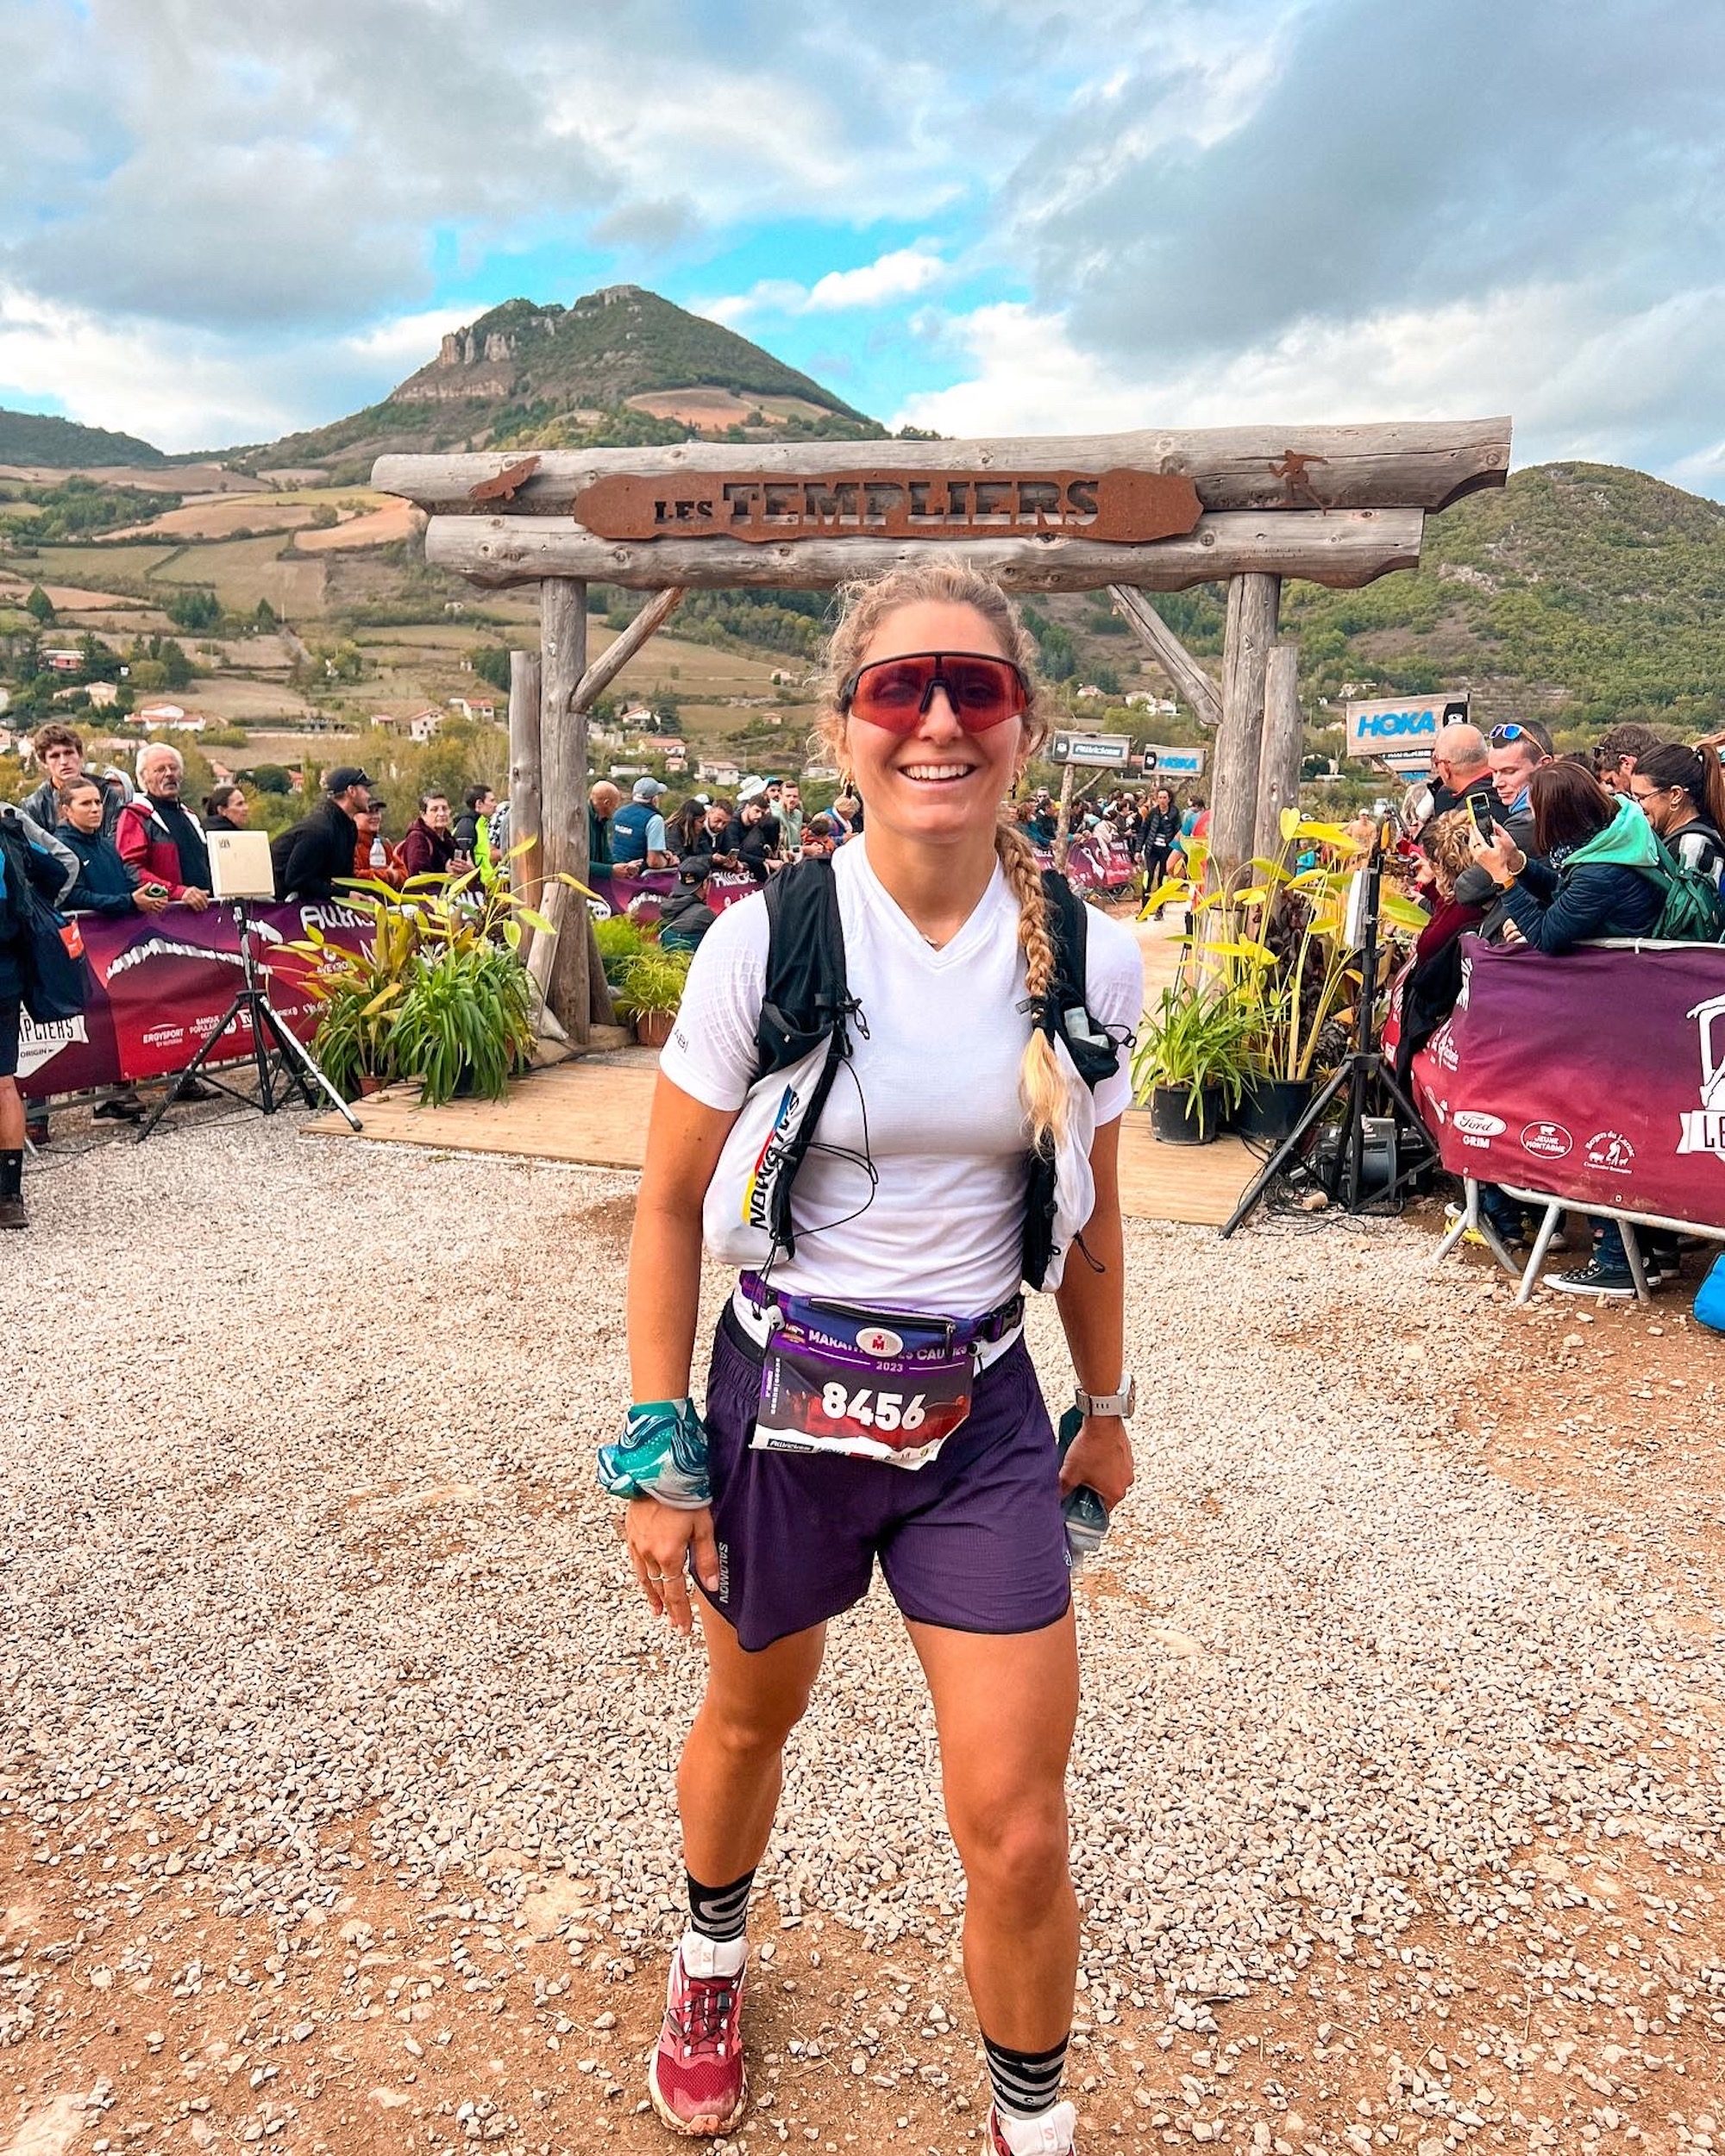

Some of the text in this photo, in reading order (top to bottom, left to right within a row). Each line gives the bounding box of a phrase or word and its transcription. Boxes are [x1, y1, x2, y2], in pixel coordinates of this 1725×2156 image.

[655, 479, 1100, 526] LES TEMPLIERS
[1357, 710, 1437, 738] HOKA
[1459, 1114, 1494, 1131] Ford
[875, 1361, 904, 1373] 2023
[821, 1381, 926, 1432] 8456
